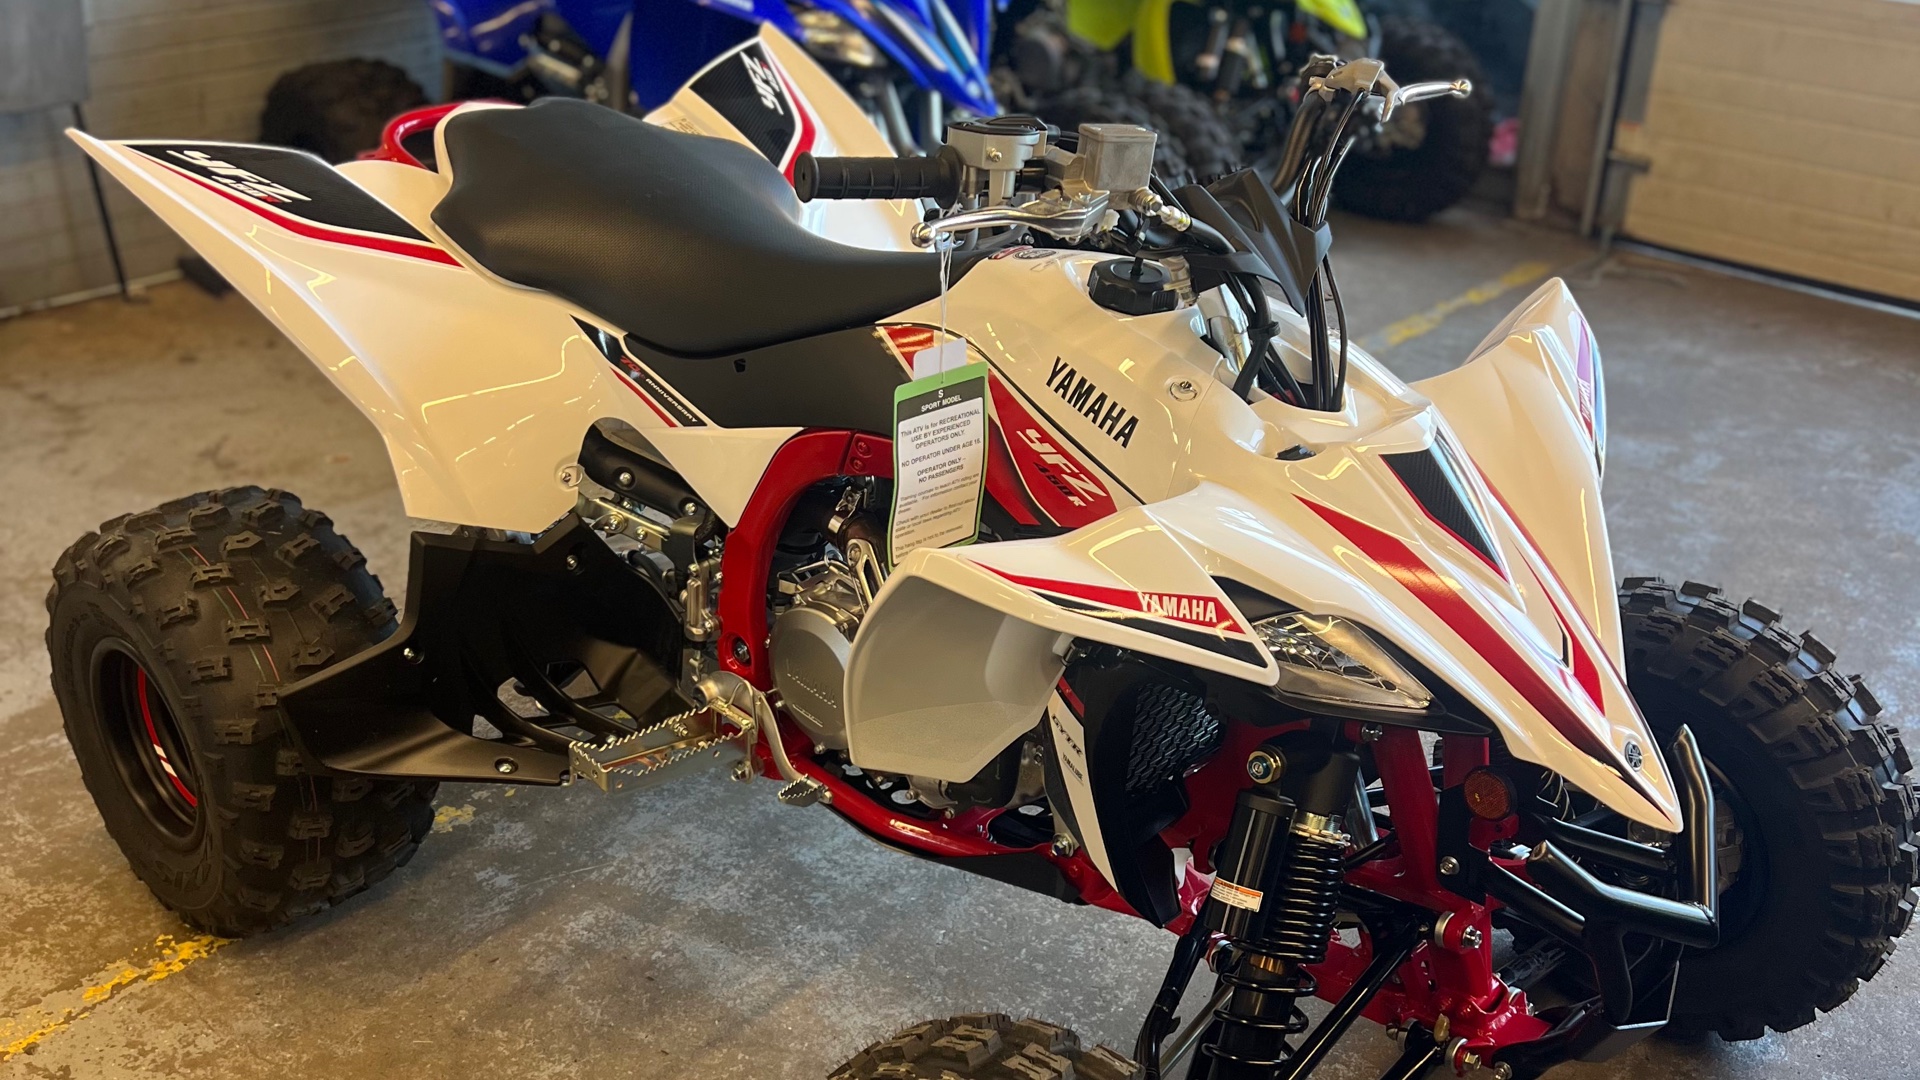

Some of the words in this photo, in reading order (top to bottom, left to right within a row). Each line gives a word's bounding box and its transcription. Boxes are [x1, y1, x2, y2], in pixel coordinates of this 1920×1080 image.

[166, 150, 312, 203] YFZ
[645, 378, 698, 423] ANNIVERSARY
[921, 401, 940, 412] SPORT
[942, 395, 962, 406] MODEL
[1045, 355, 1139, 449] YAMAHA
[939, 409, 980, 425] RECREATIONAL
[911, 434, 922, 442] USE
[933, 420, 970, 436] EXPERIENCED
[916, 434, 949, 449] OPERATORS
[911, 450, 940, 464] OPERATOR
[942, 445, 961, 455] UNDER
[962, 440, 973, 448] AGE
[917, 462, 947, 476] OPERATOR
[948, 457, 961, 466] ONLY
[928, 465, 963, 480] PASSENGERS
[1016, 428, 1108, 502] YFZ
[1137, 592, 1218, 623] YAMAHA
